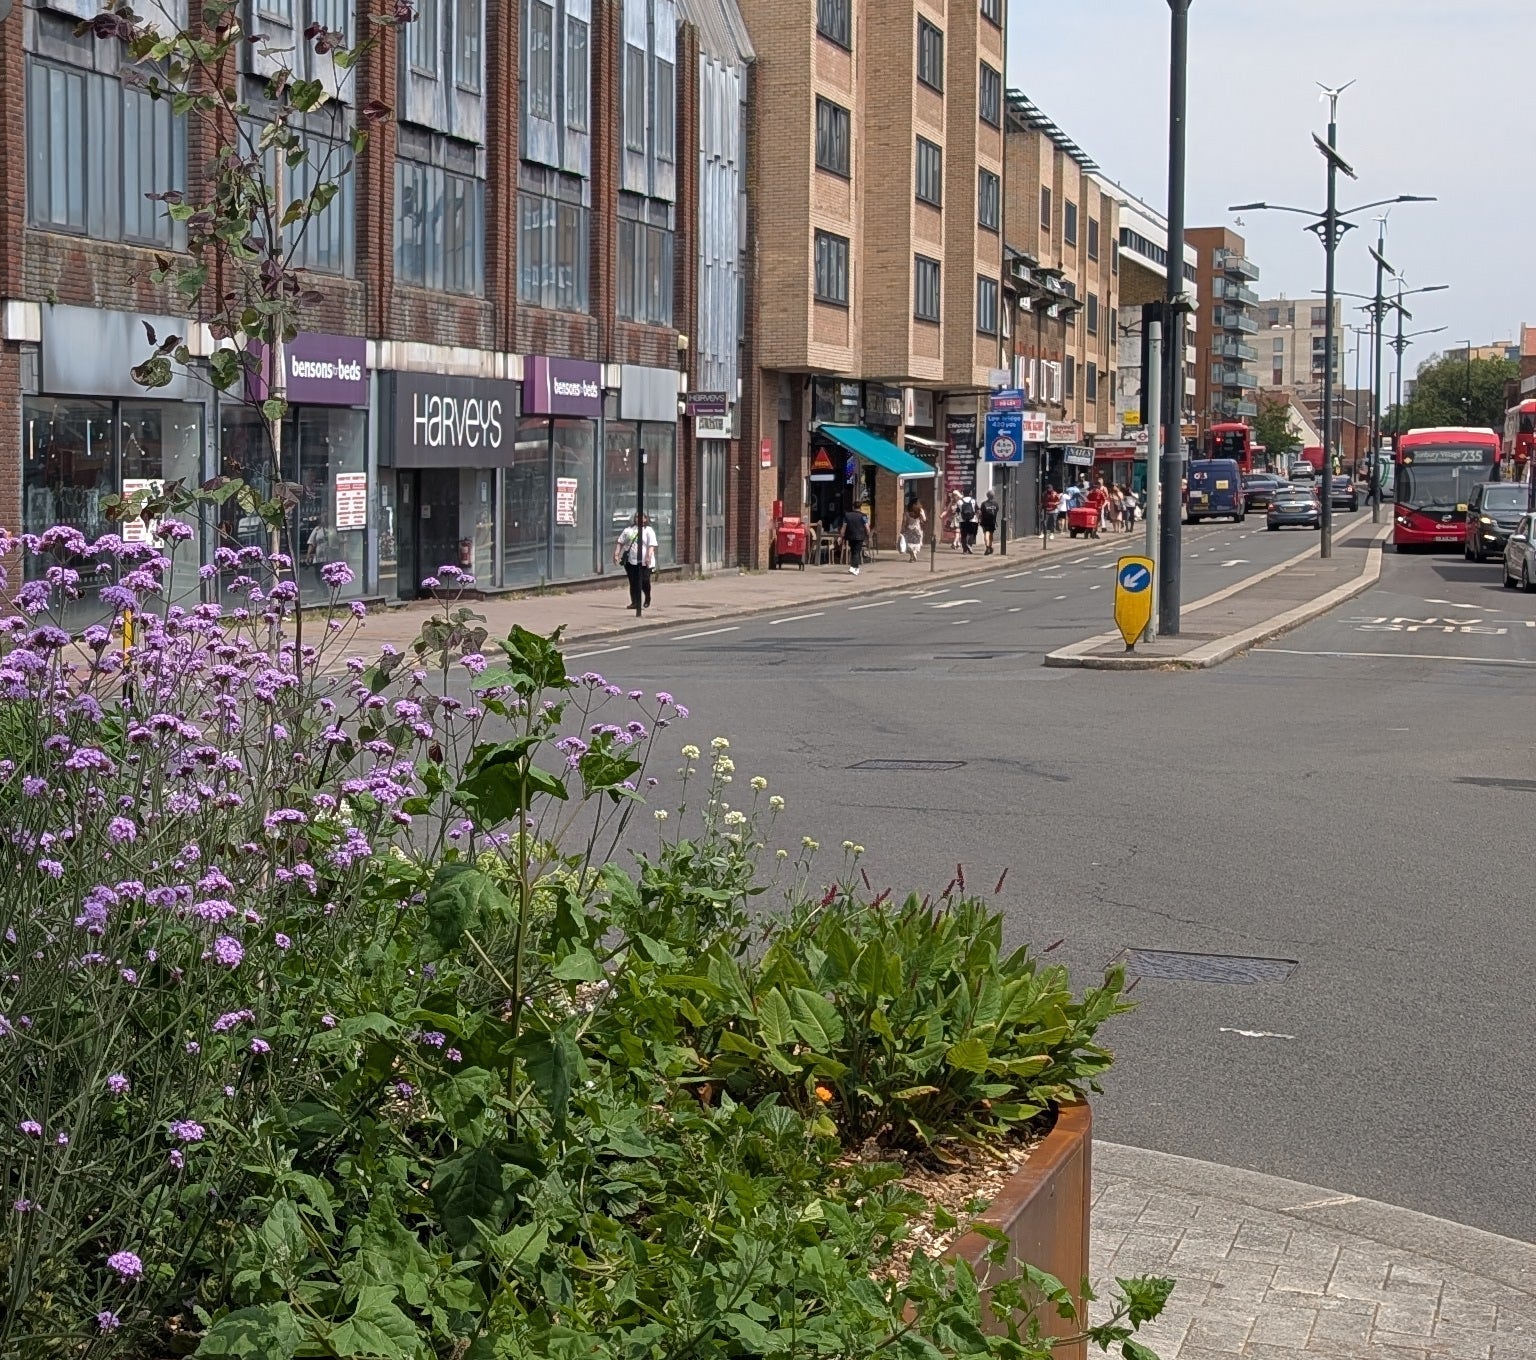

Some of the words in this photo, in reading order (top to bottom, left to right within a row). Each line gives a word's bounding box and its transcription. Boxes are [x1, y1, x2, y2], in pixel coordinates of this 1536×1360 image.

[291, 354, 334, 379] bensons
[337, 358, 362, 381] beds
[1461, 450, 1483, 462] 235
